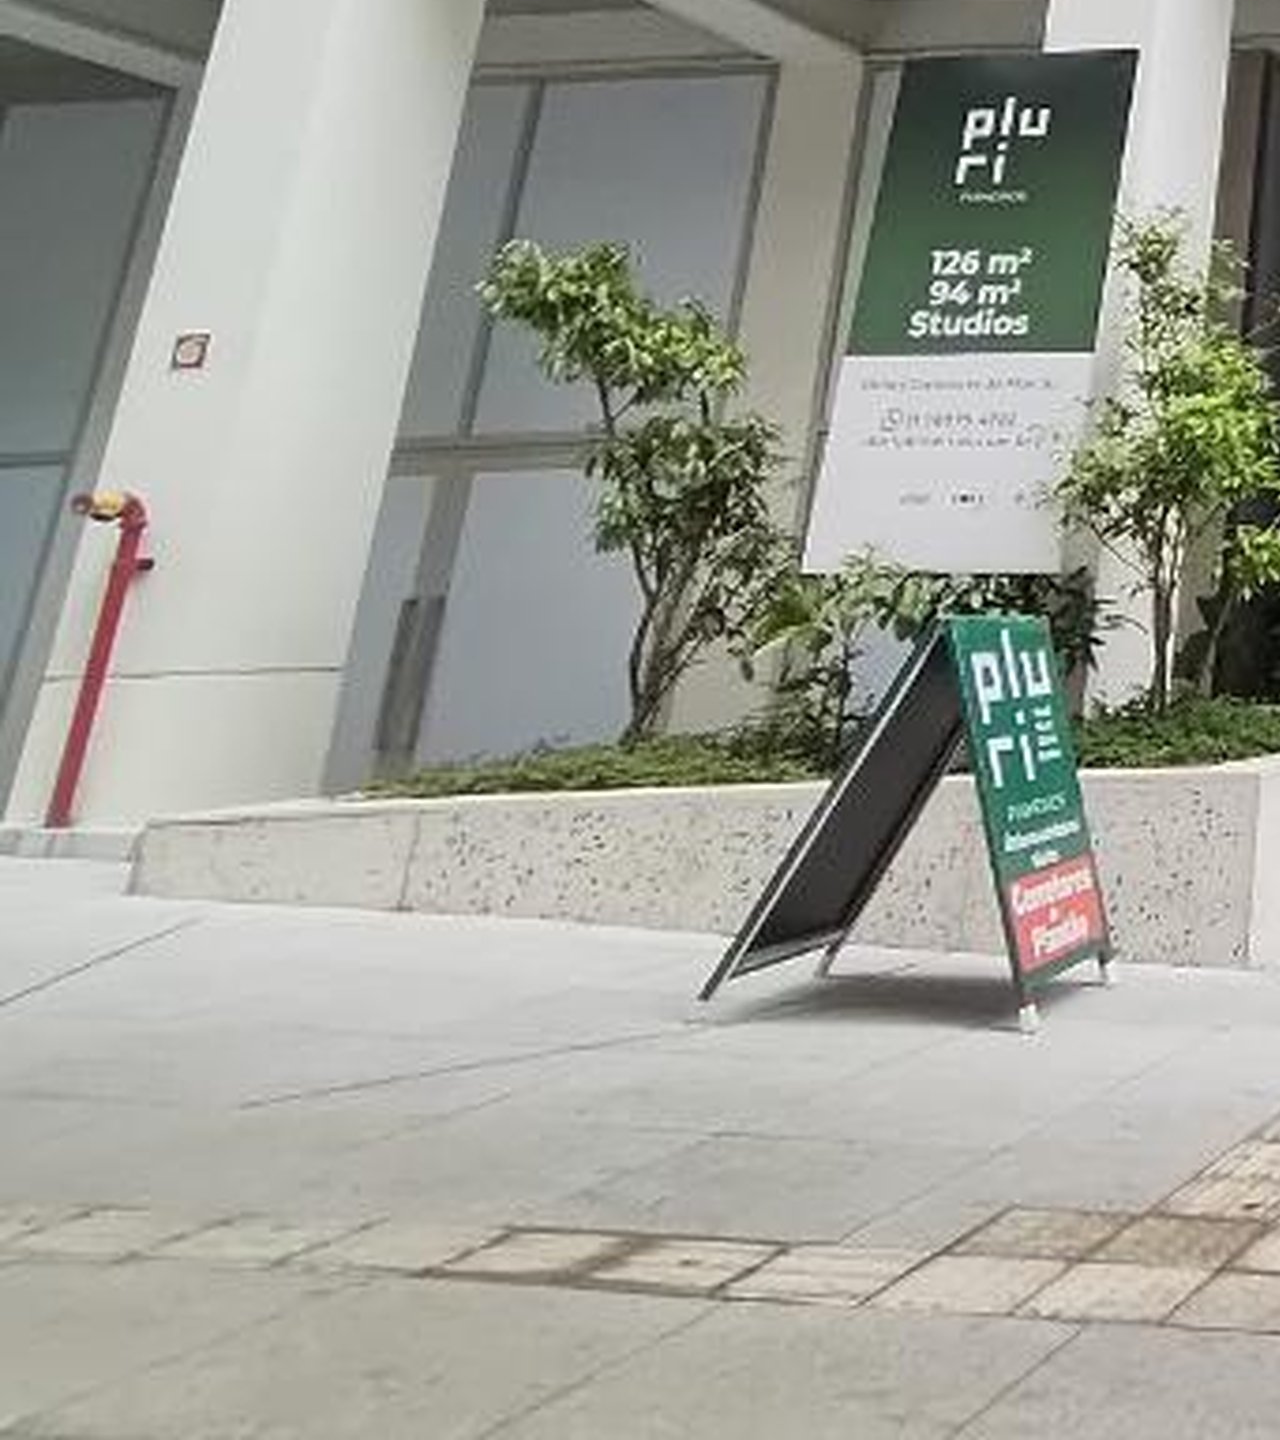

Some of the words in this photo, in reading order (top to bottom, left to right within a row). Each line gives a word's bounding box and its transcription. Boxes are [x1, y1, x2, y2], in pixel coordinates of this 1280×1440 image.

[931, 248, 980, 275] 126
[929, 280, 973, 305] 94
[908, 308, 1029, 338] Studios
